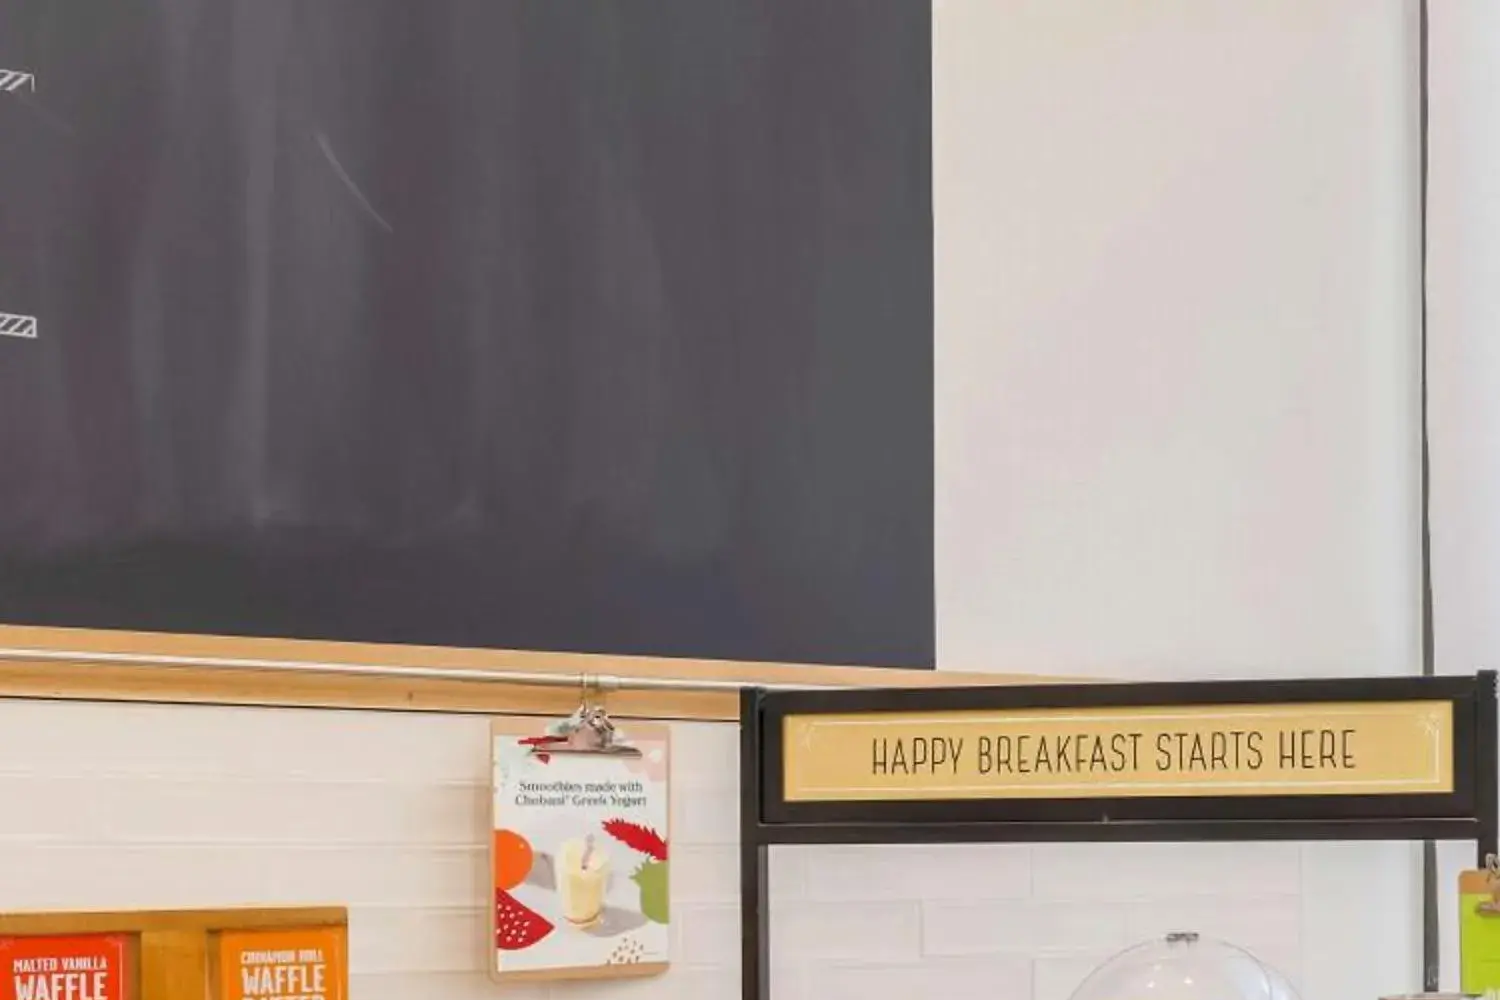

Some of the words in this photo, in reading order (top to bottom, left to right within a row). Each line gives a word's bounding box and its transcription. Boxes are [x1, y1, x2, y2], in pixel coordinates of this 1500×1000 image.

[871, 735, 964, 776] HAPPY
[978, 732, 1144, 774] BREAKFAST
[1155, 729, 1264, 772] STARTS
[1279, 728, 1357, 770] HERE
[13, 957, 58, 973] MALTED
[61, 955, 107, 971] VANILLA
[242, 964, 327, 995] WAFFLE
